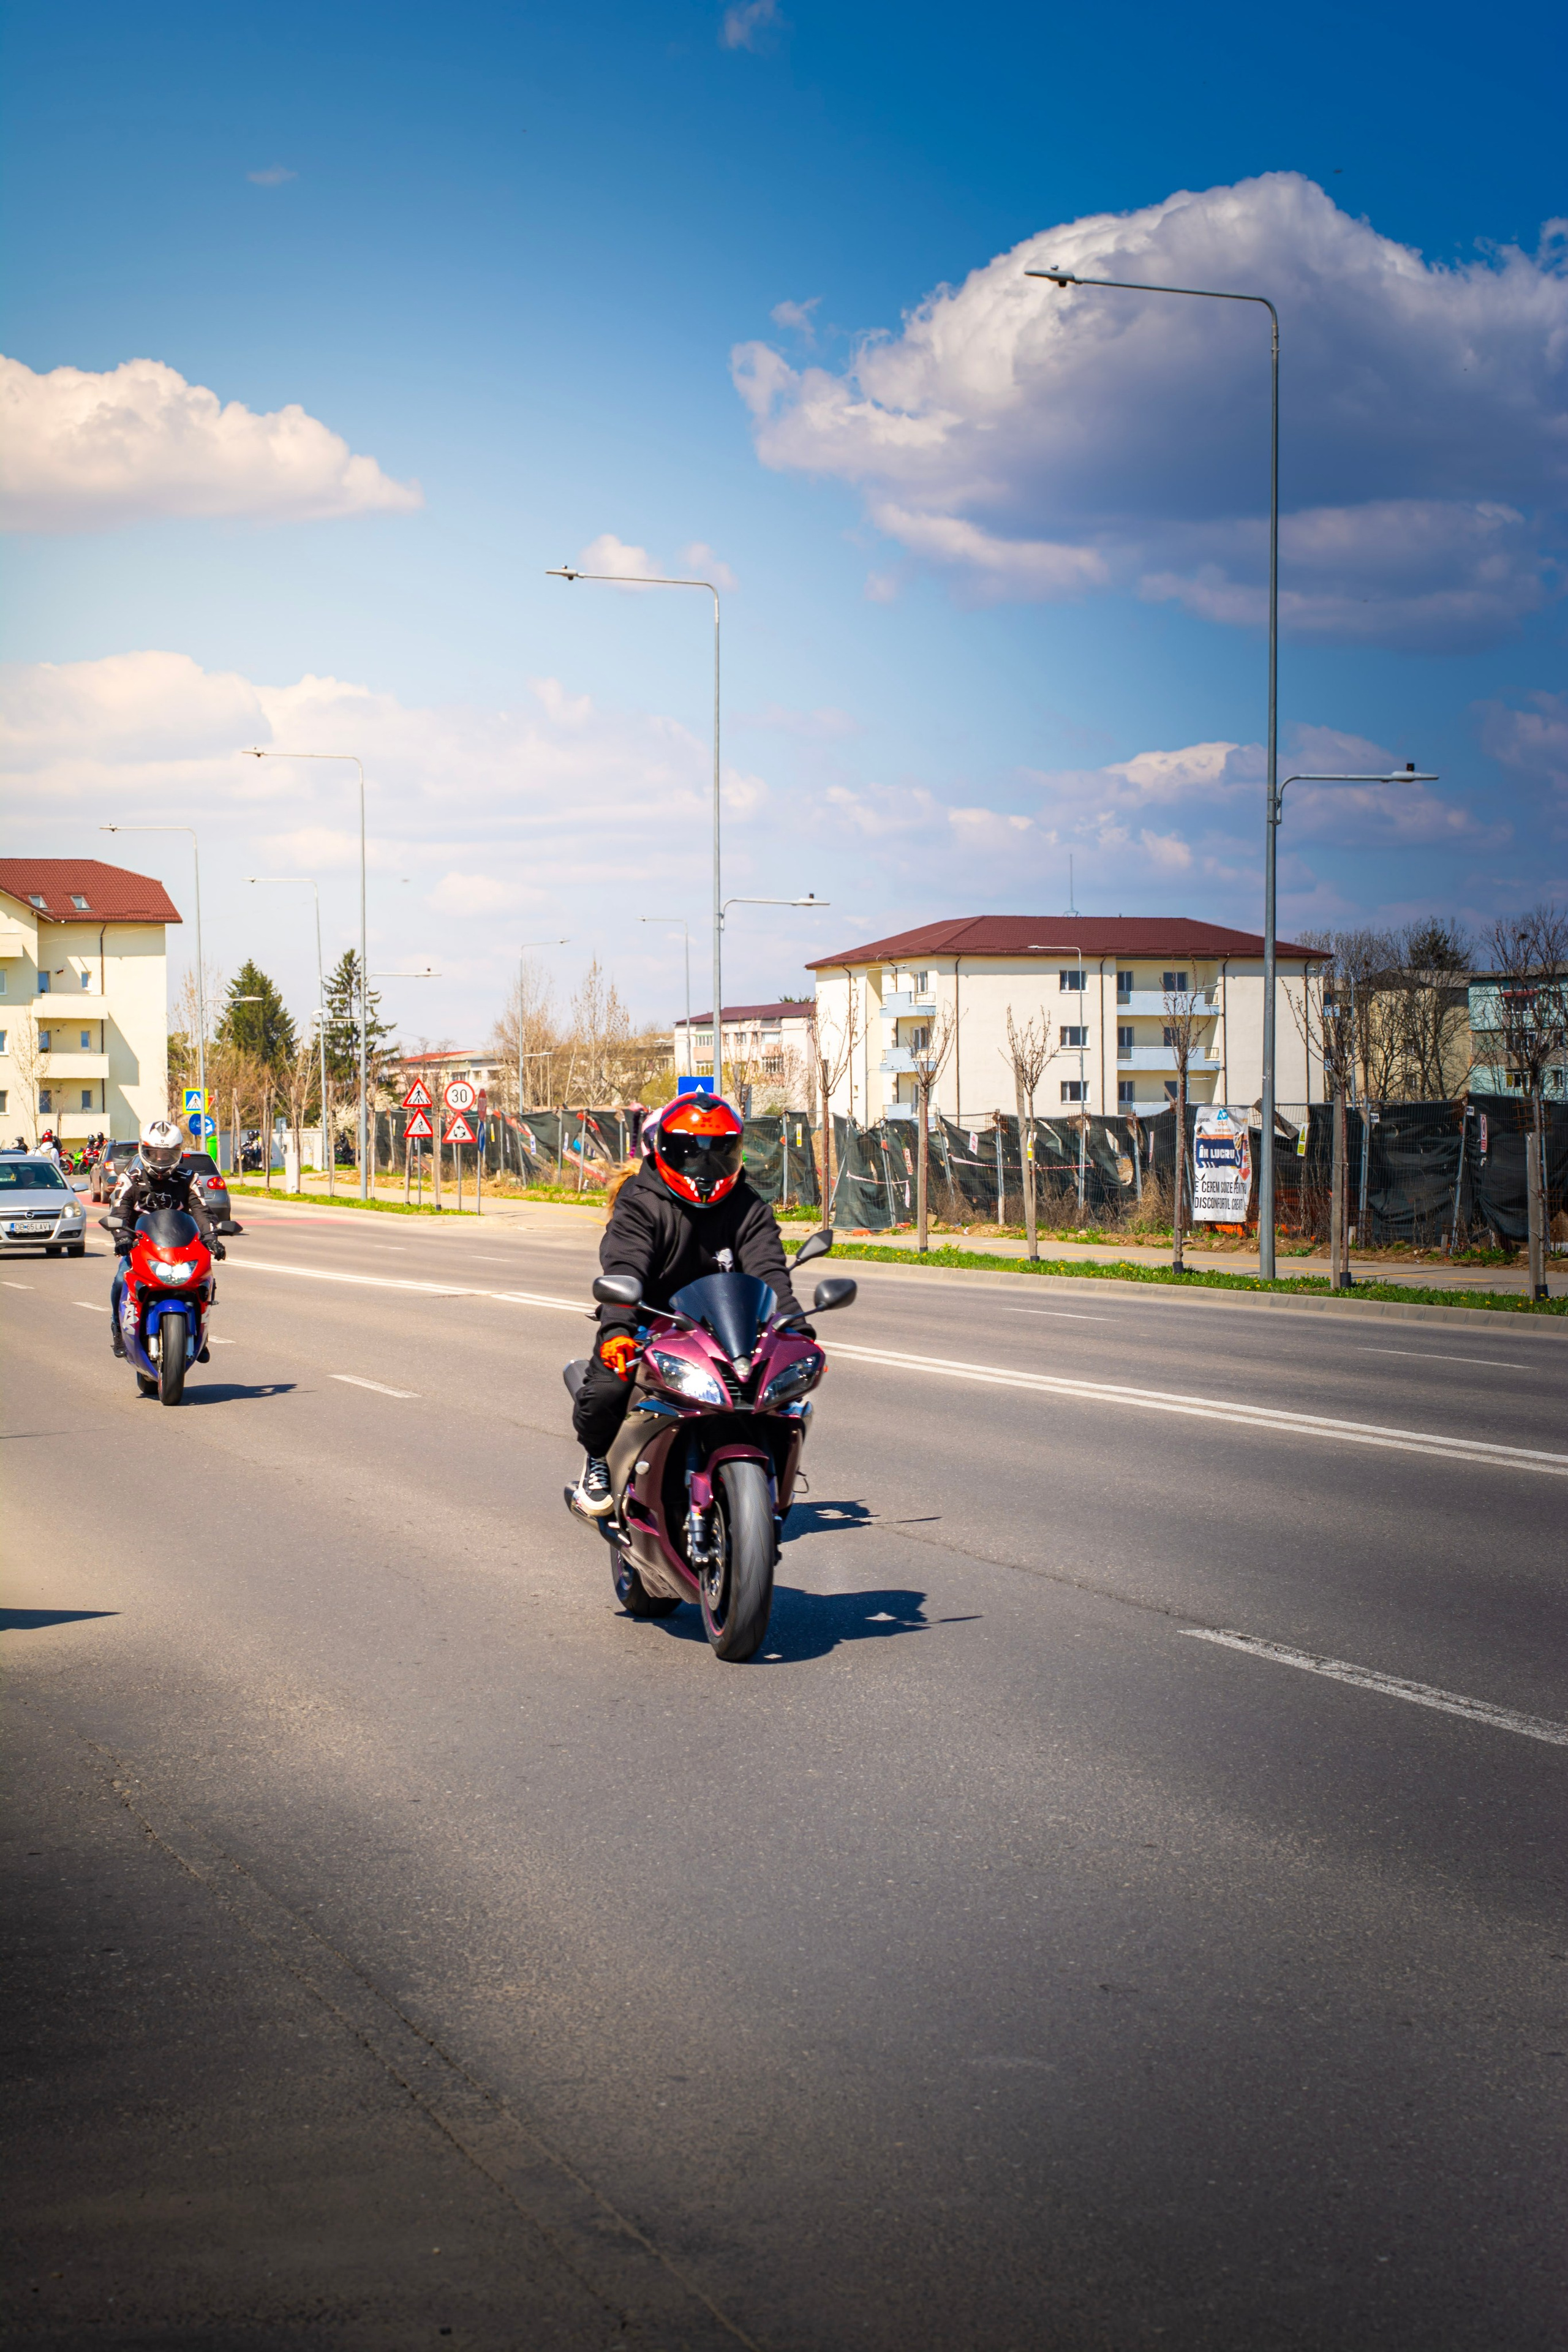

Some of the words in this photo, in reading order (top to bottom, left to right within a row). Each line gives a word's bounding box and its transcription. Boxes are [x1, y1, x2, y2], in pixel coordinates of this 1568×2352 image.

[451, 1089, 467, 1103] 30
[1199, 1144, 1209, 1158] ÎN
[1210, 1148, 1235, 1159] LUCRU
[1194, 1181, 1199, 1193] E
[1201, 1181, 1220, 1193] CEREM
[1194, 1197, 1231, 1210] DISCONFORTUL
